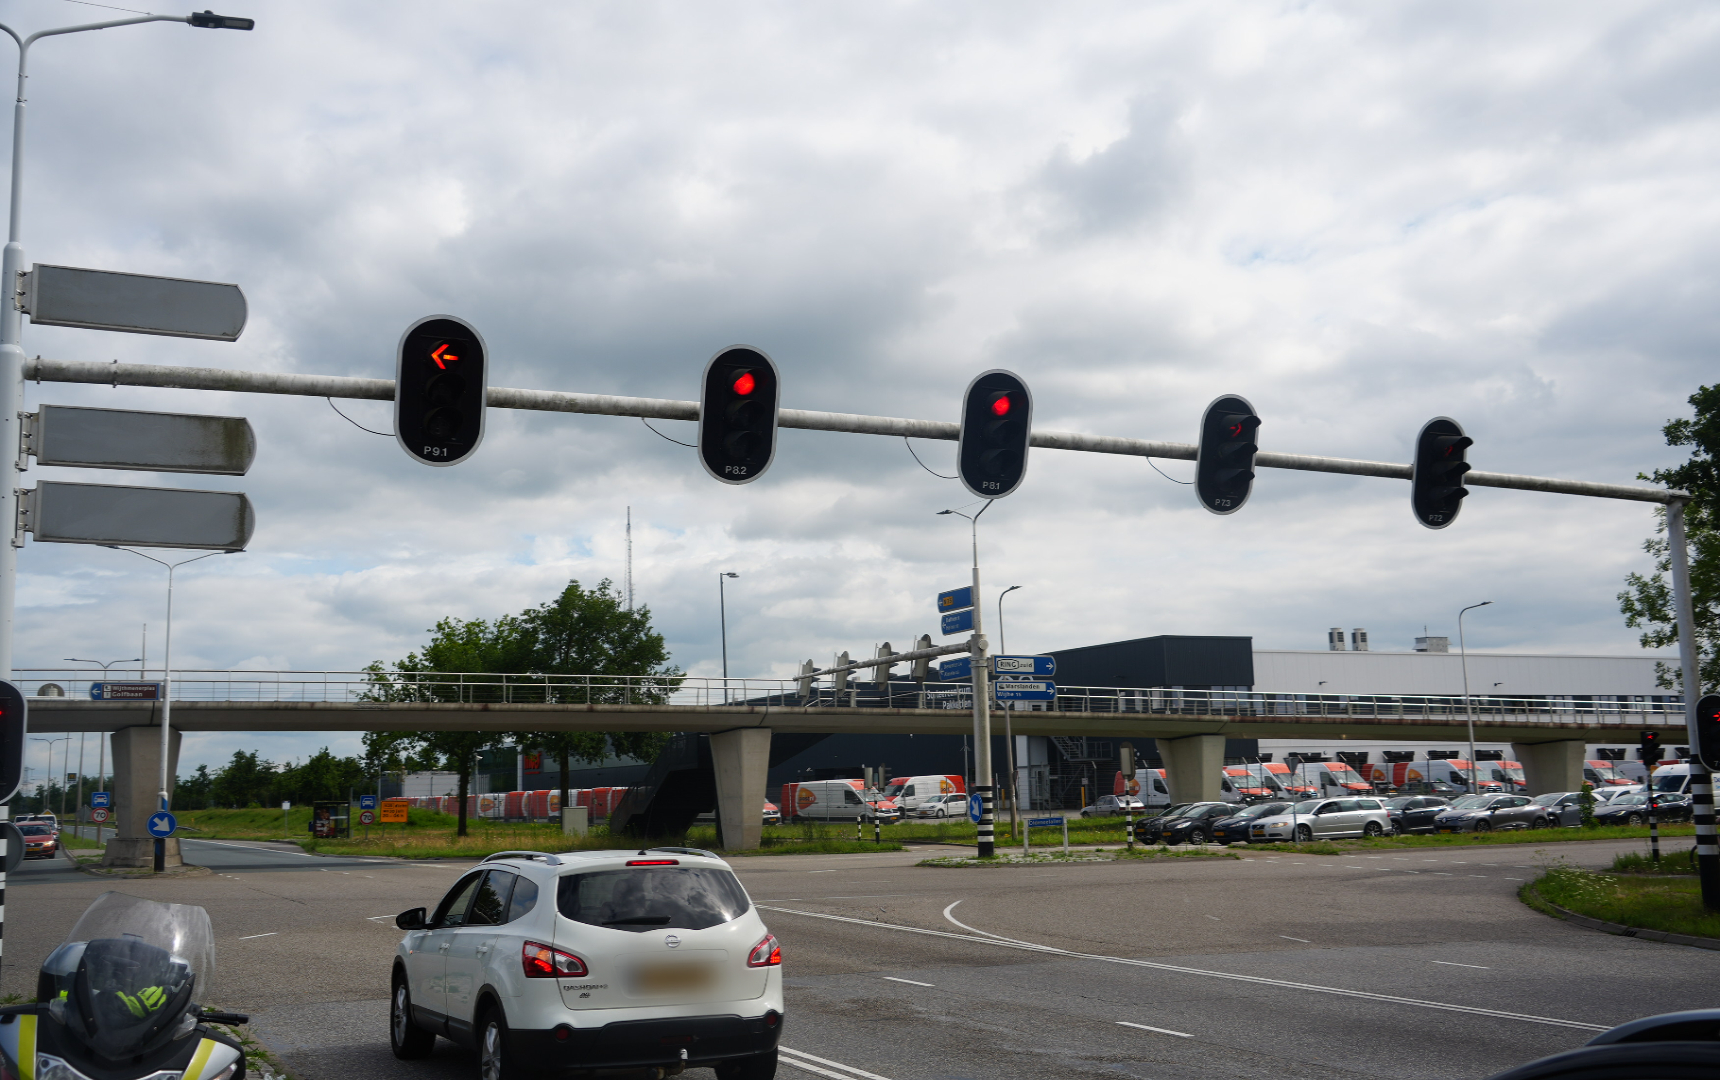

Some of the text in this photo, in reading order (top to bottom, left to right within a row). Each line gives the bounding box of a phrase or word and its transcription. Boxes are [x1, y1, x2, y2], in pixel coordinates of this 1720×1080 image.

[423, 446, 447, 456] P9.1
[725, 465, 746, 474] P8.2
[982, 481, 1000, 490] P8.1
